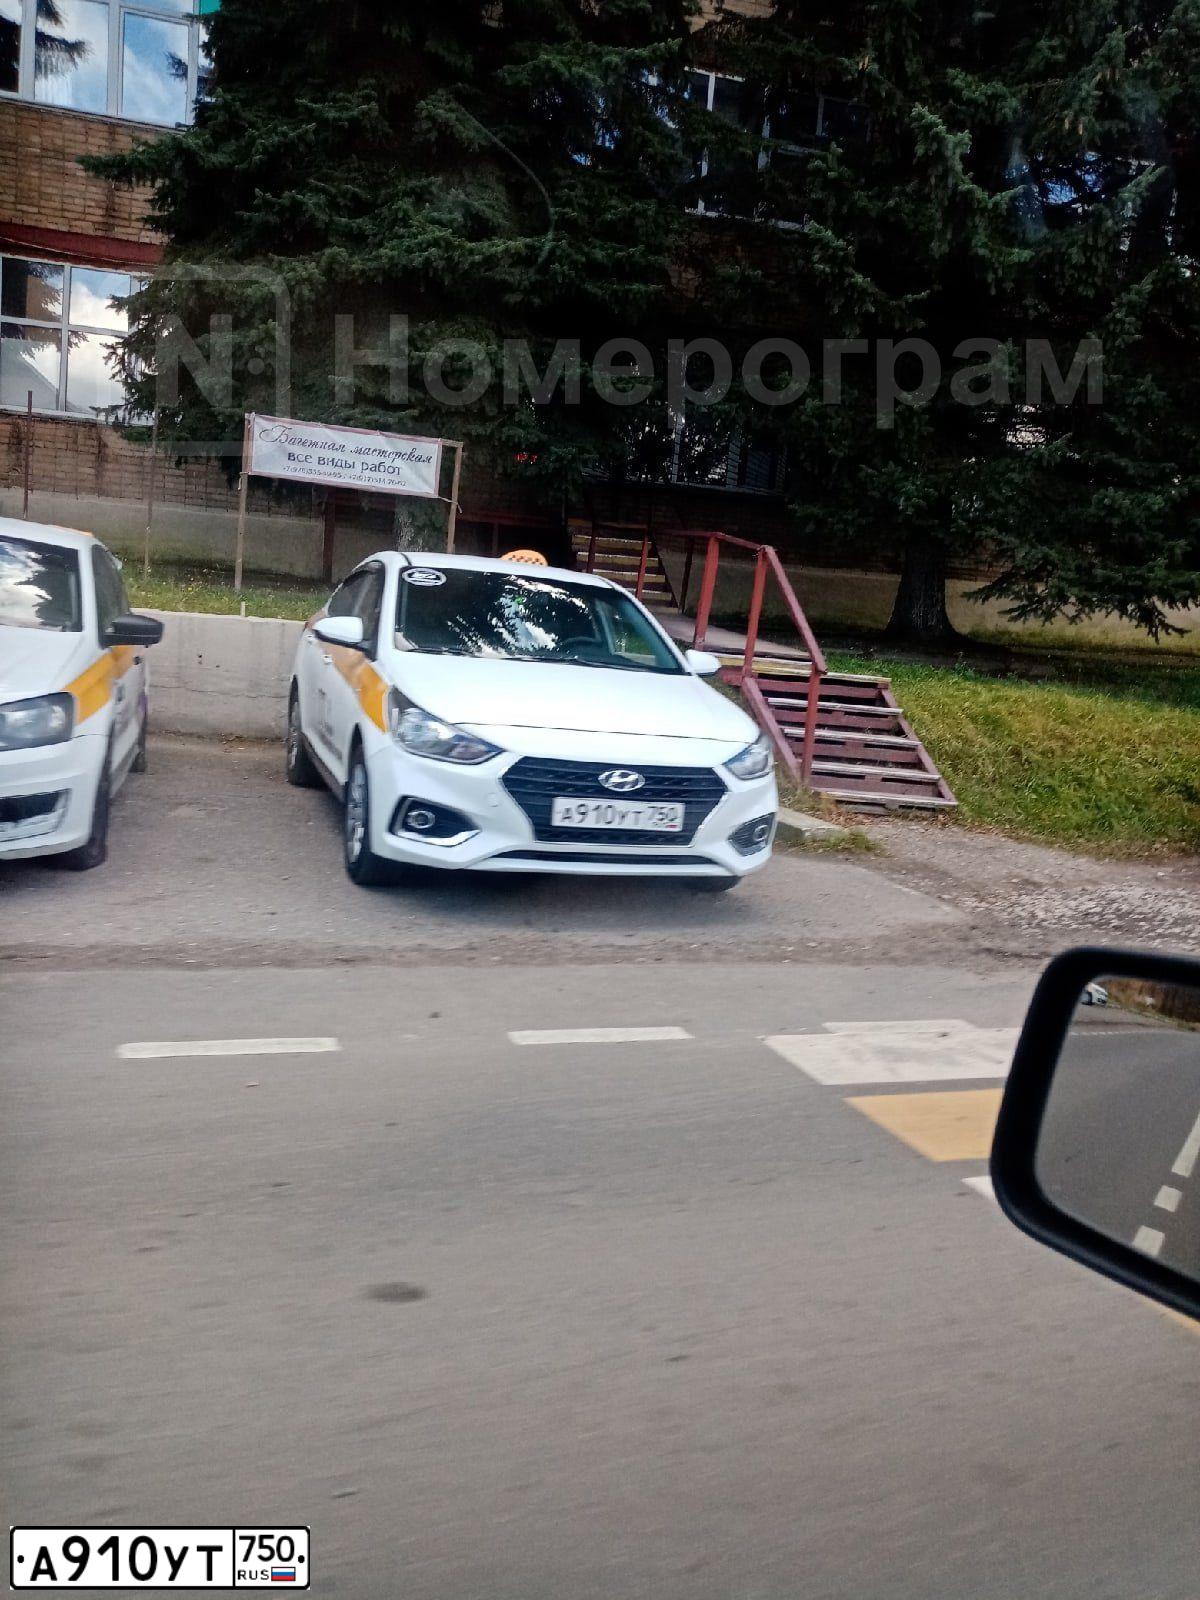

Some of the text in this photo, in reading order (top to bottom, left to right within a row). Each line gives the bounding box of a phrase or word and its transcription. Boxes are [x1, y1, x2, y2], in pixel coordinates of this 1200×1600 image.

[259, 425, 433, 465] Багетная мастерская
[287, 452, 401, 476] все виды работ
[647, 806, 679, 822] 750
